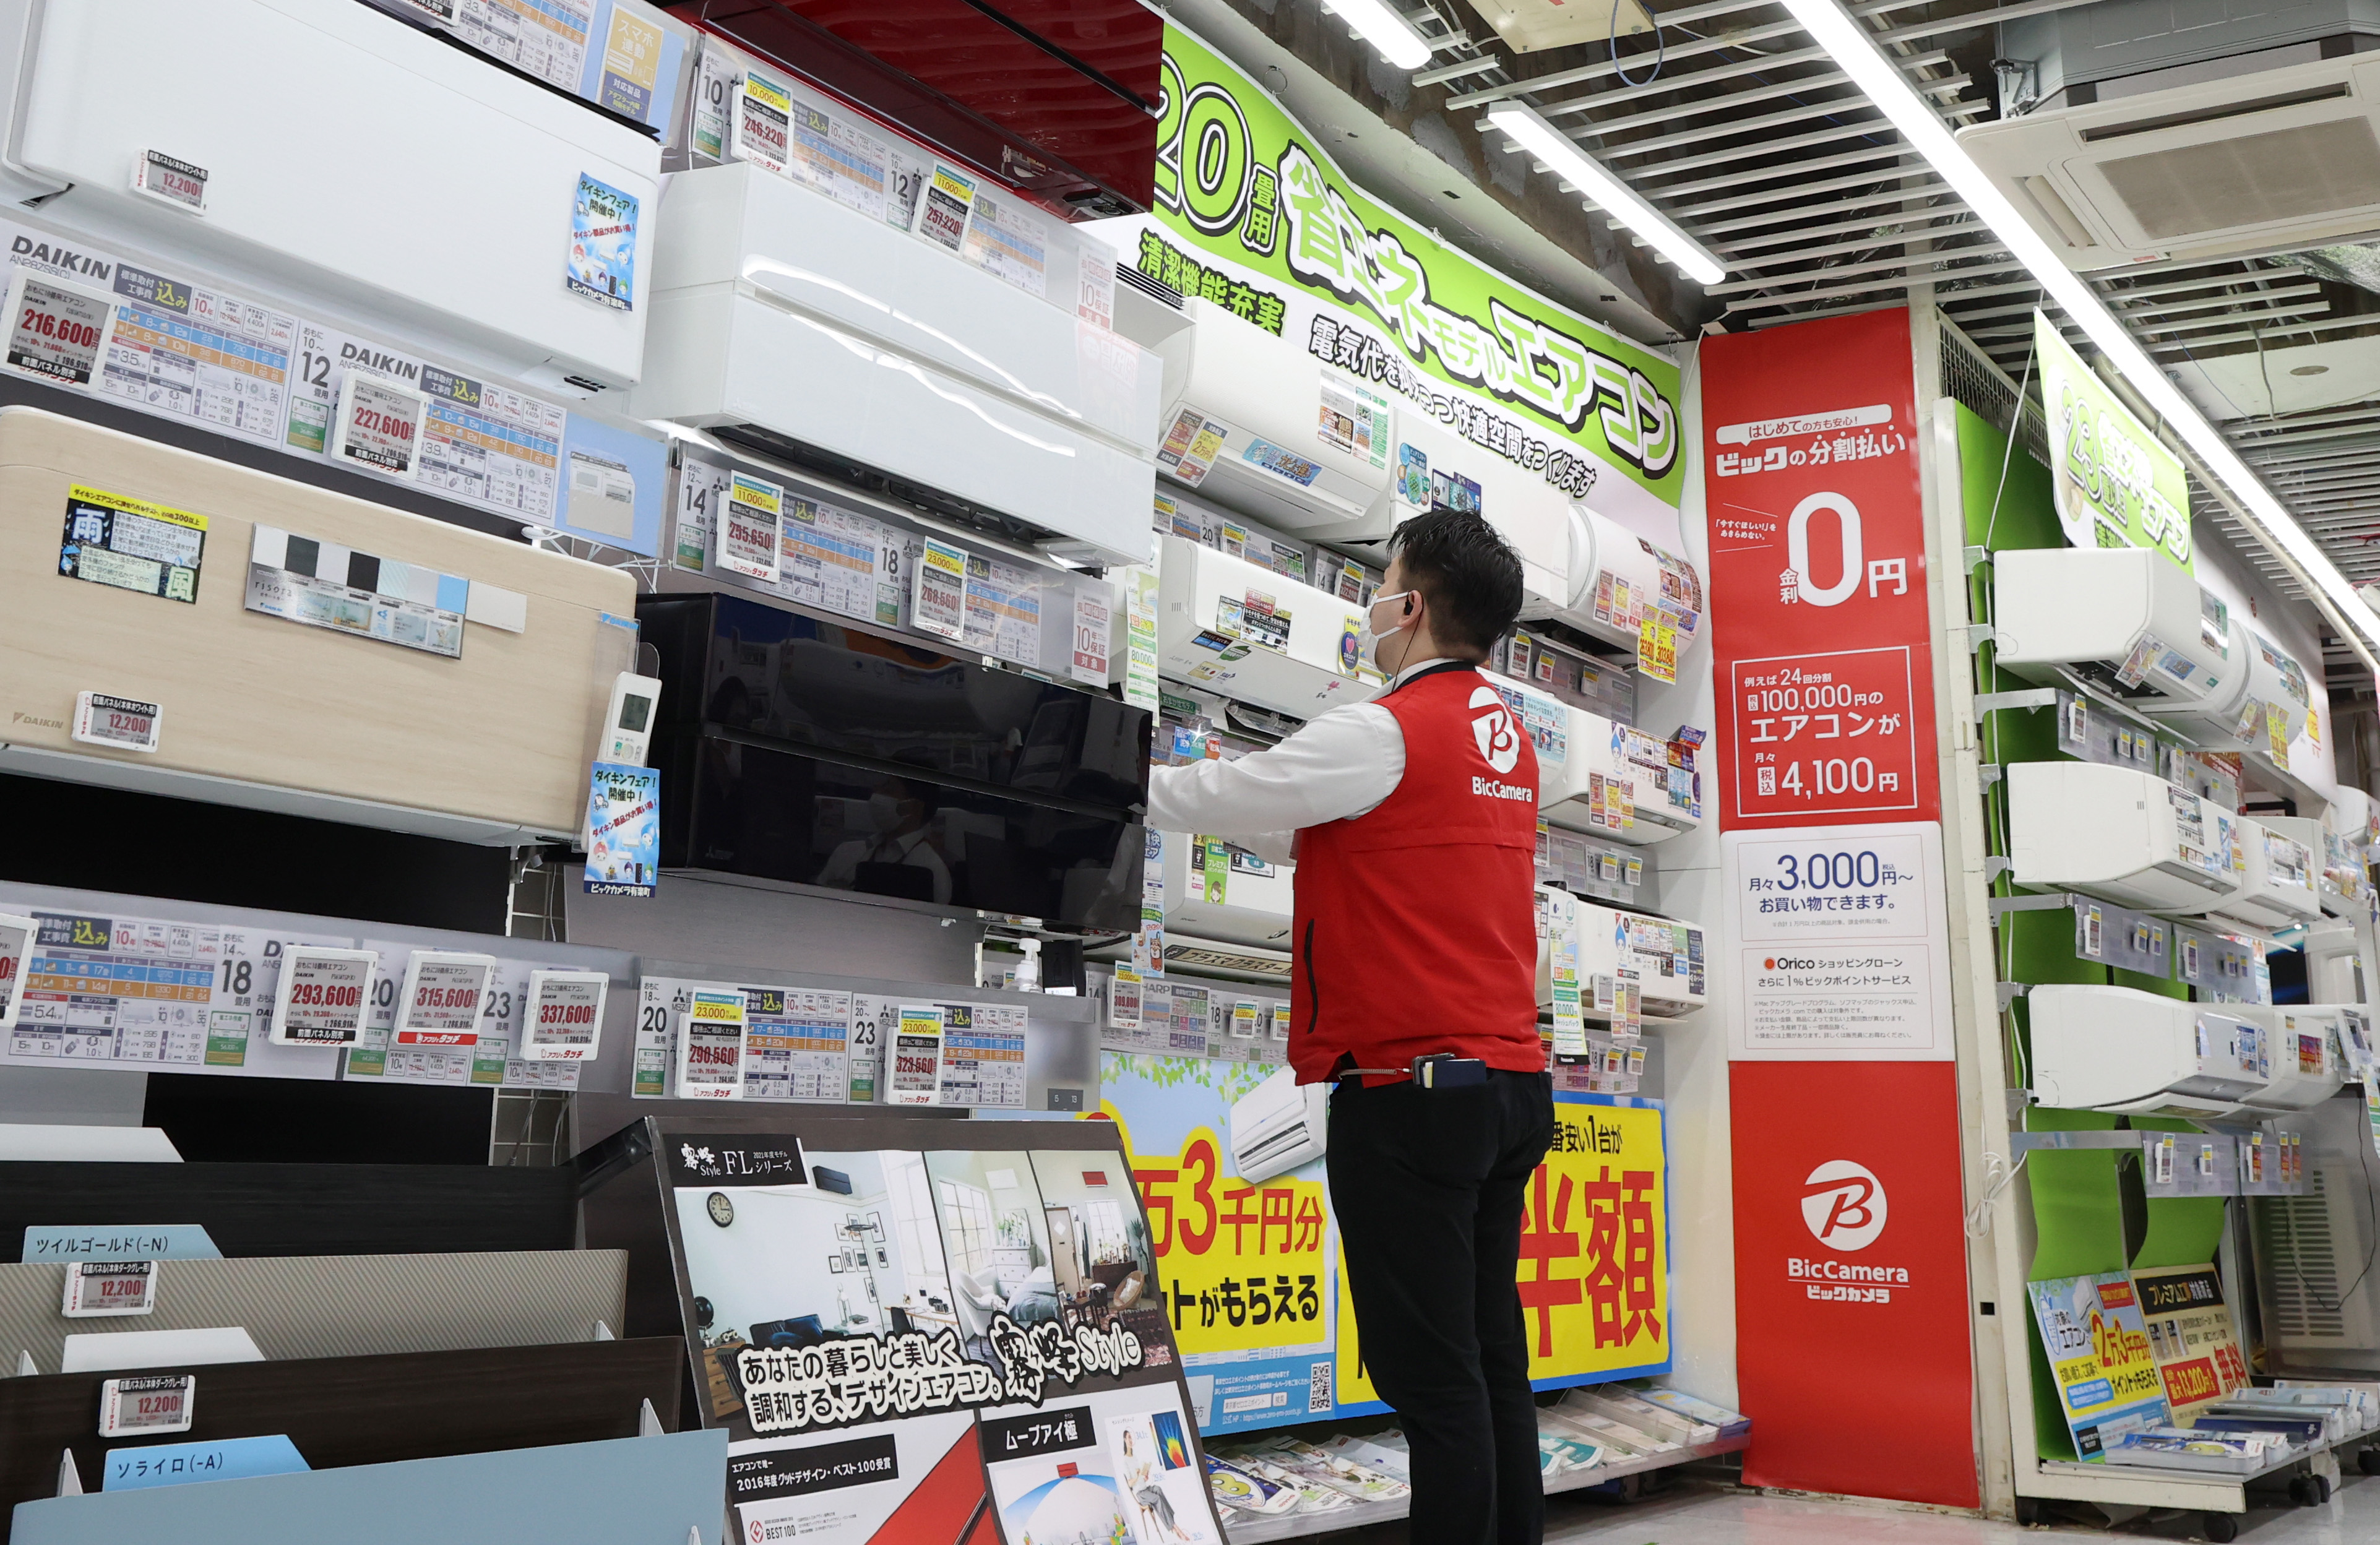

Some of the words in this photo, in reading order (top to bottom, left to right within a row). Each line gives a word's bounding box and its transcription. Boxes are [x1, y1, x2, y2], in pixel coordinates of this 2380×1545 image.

[618, 19, 655, 48] スマホ
[703, 74, 723, 105] 10
[749, 84, 775, 104] 10,000
[743, 117, 783, 149] 246,220
[808, 111, 828, 132] 込み
[163, 171, 199, 197] 12,200
[890, 170, 909, 199] 12
[937, 176, 959, 195] 11,000
[580, 179, 637, 214] ダイキンフェア！
[589, 199, 622, 222] 開催中！
[927, 206, 960, 236] 257,220
[1241, 165, 1278, 254] 畳用
[11, 236, 111, 281] DAIKIN
[127, 283, 153, 301] 工事費
[155, 280, 188, 309] 込み
[571, 280, 626, 309] ビックカメラ有楽町
[1081, 280, 1095, 308] 10
[1137, 229, 1286, 337] 清潔機能充実
[24, 295, 46, 306] DAIKIN
[194, 298, 215, 317] 10年
[21, 308, 93, 348] 216,600
[303, 326, 324, 341] おもに
[21, 355, 77, 379] 前面パネル別売
[301, 351, 331, 388] 12
[340, 342, 418, 381] DAIKIN
[313, 387, 329, 400] 畳用
[452, 379, 480, 405] 込み
[483, 392, 501, 409] 10年
[1308, 314, 1597, 499] 電気代を抑えつつ快適空間をつくります
[353, 407, 410, 441] 227,600
[1748, 416, 1858, 439] はじめての方も安心！
[354, 447, 399, 468] 前面パネル別売
[1716, 431, 1906, 477] ビックの分割払い
[686, 484, 706, 515] 14
[738, 489, 763, 507] 11,000
[796, 501, 815, 521] 込み
[71, 507, 106, 544] 雨
[1202, 525, 1214, 543] 20
[1720, 530, 1766, 540] あきらめない。
[1787, 491, 1863, 607] 0
[882, 547, 899, 575] 18
[928, 554, 951, 570] 23,000
[165, 566, 195, 603] 風
[255, 580, 293, 598] risora
[1779, 567, 1798, 605] 金利
[1868, 557, 1908, 598] 円
[1076, 624, 1090, 652] 10
[1090, 641, 1106, 657] 保証
[1080, 655, 1098, 669] 対象
[1744, 667, 1832, 687] 例えば24回分割
[1761, 683, 1884, 712] 100,000円の
[23, 715, 64, 730] DAIKIN
[108, 713, 147, 733] 12,200
[1750, 711, 1902, 743] エアコンが
[1754, 752, 1776, 763] 月々
[594, 769, 657, 788] ダイキンフェア！
[1472, 775, 1533, 803] BicCamera
[1760, 768, 1774, 794] 税込
[1782, 757, 1899, 799] 4,100円
[608, 786, 644, 803] 開催中！
[592, 799, 658, 838] ダイキン製品がお買い得！
[590, 883, 651, 898] ビックカメラ有楽町
[1759, 893, 1895, 913] お買い物できます。
[72, 920, 109, 945] 込み
[114, 930, 137, 947] 10年
[223, 933, 245, 944] おもに
[1777, 958, 1815, 970] Orico
[1818, 958, 1903, 969] ショッピングローン
[222, 960, 252, 996] 18
[291, 983, 356, 1008] 293,600
[416, 986, 474, 1009] 315,600
[762, 992, 783, 1012] 込み
[35, 1005, 55, 1019] 5.4
[540, 1004, 591, 1025] 337,600
[642, 1006, 667, 1033] 20
[696, 1005, 726, 1018] 23,000
[1211, 1006, 1221, 1024] 18
[297, 1028, 345, 1040] 前面パネル別売
[422, 1034, 460, 1044] アプリでタッチ
[855, 1021, 876, 1045] 23
[903, 1023, 928, 1034] 23,000
[546, 1049, 584, 1059] アプリでタッチ
[689, 1045, 735, 1065] 290,560
[722, 1150, 754, 1175] FL
[752, 1150, 788, 1160] 2021年度モデル
[756, 1159, 793, 1174] シリーズ
[700, 1164, 721, 1177] Style
[1134, 1138, 1323, 1259] 万3千円分
[37, 1236, 168, 1254] ツイルゴールド(-N)
[1516, 1163, 1662, 1358] 半額
[1788, 1257, 1909, 1283] BicCamera
[101, 1280, 142, 1297] 12,200
[1806, 1285, 1891, 1304] ビックカメラ
[1162, 1275, 1319, 1332] トがもらえる
[744, 1330, 960, 1385] あなたの暮らしと美しく
[1077, 1322, 1141, 1376] Style
[138, 1395, 178, 1414] 12,200
[751, 1369, 1001, 1425] 調和する、デザインエアコン。
[1006, 1419, 1078, 1450] ムーブアイ極
[118, 1452, 223, 1479] ソライロ(-A)
[731, 1460, 774, 1473] エアコンで唯一
[736, 1456, 892, 1491] 2016年度グッドデザイン・ベスト100受賞
[766, 1525, 783, 1541] BEST
[783, 1523, 796, 1538] 100
